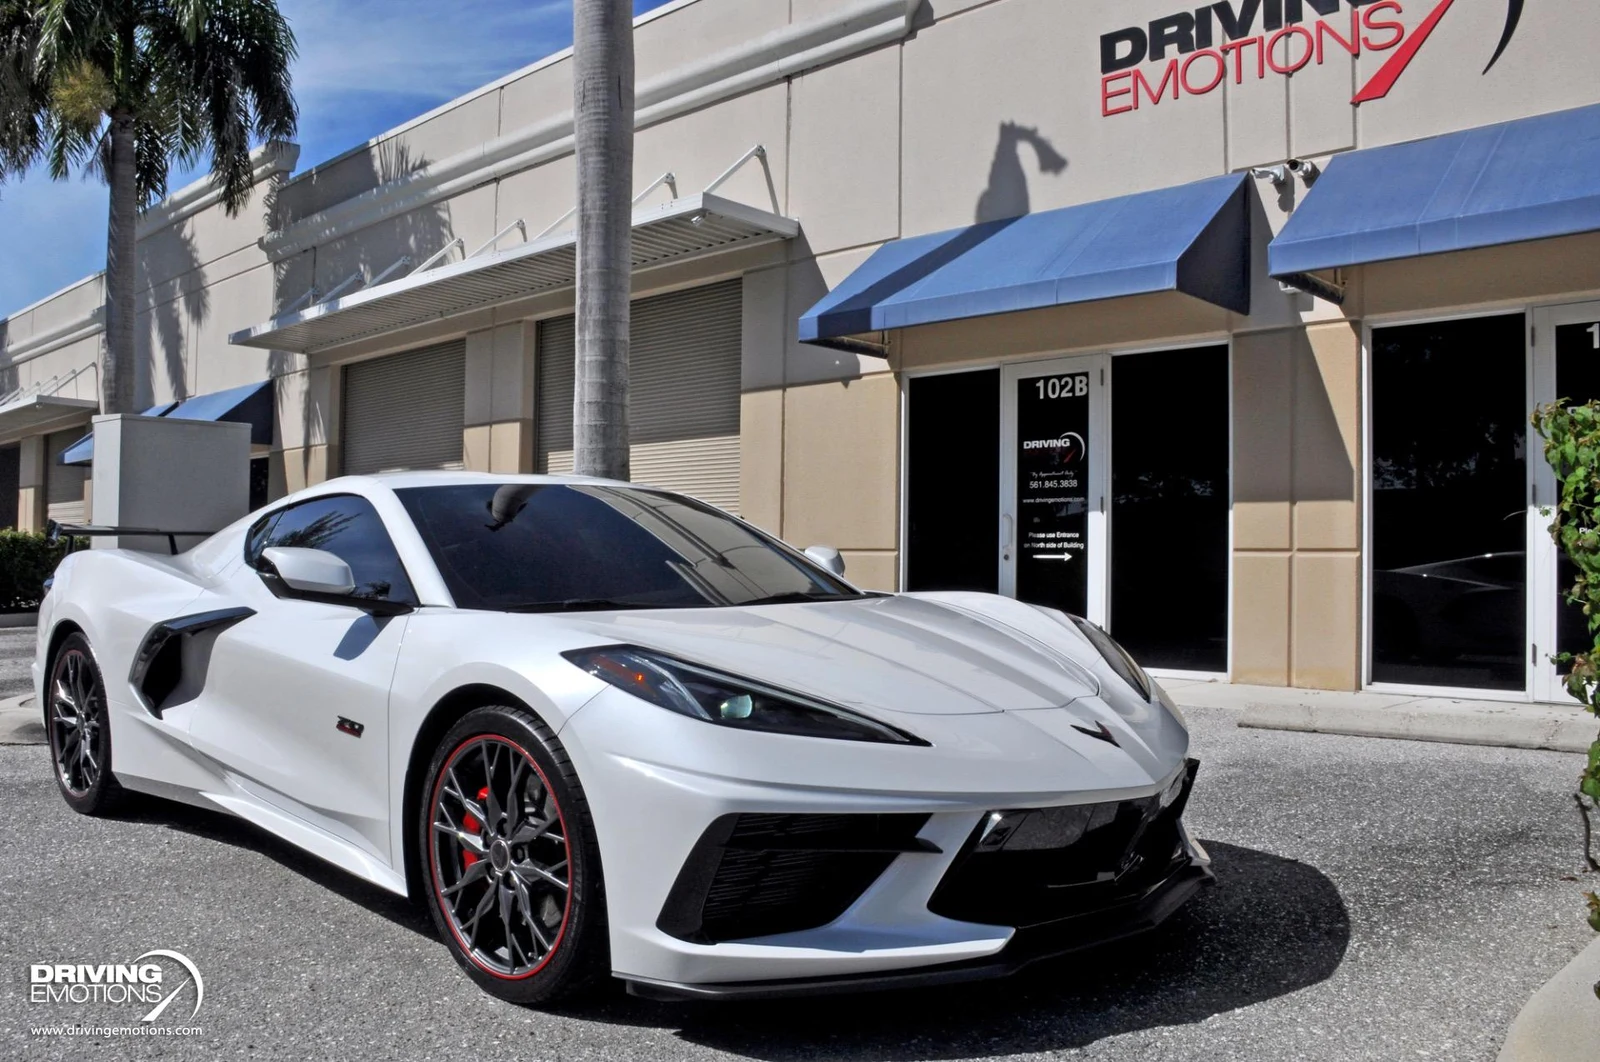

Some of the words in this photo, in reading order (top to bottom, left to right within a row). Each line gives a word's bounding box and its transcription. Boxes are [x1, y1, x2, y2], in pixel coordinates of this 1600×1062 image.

[1101, 1, 1405, 117] EMOTIONS
[1035, 375, 1088, 400] 102B
[1023, 438, 1071, 449] DRIVING
[1029, 479, 1078, 489] 561.845.3838
[1031, 541, 1046, 549] North
[1046, 541, 1057, 549] side
[1057, 541, 1063, 549] of
[1063, 541, 1085, 550] Building
